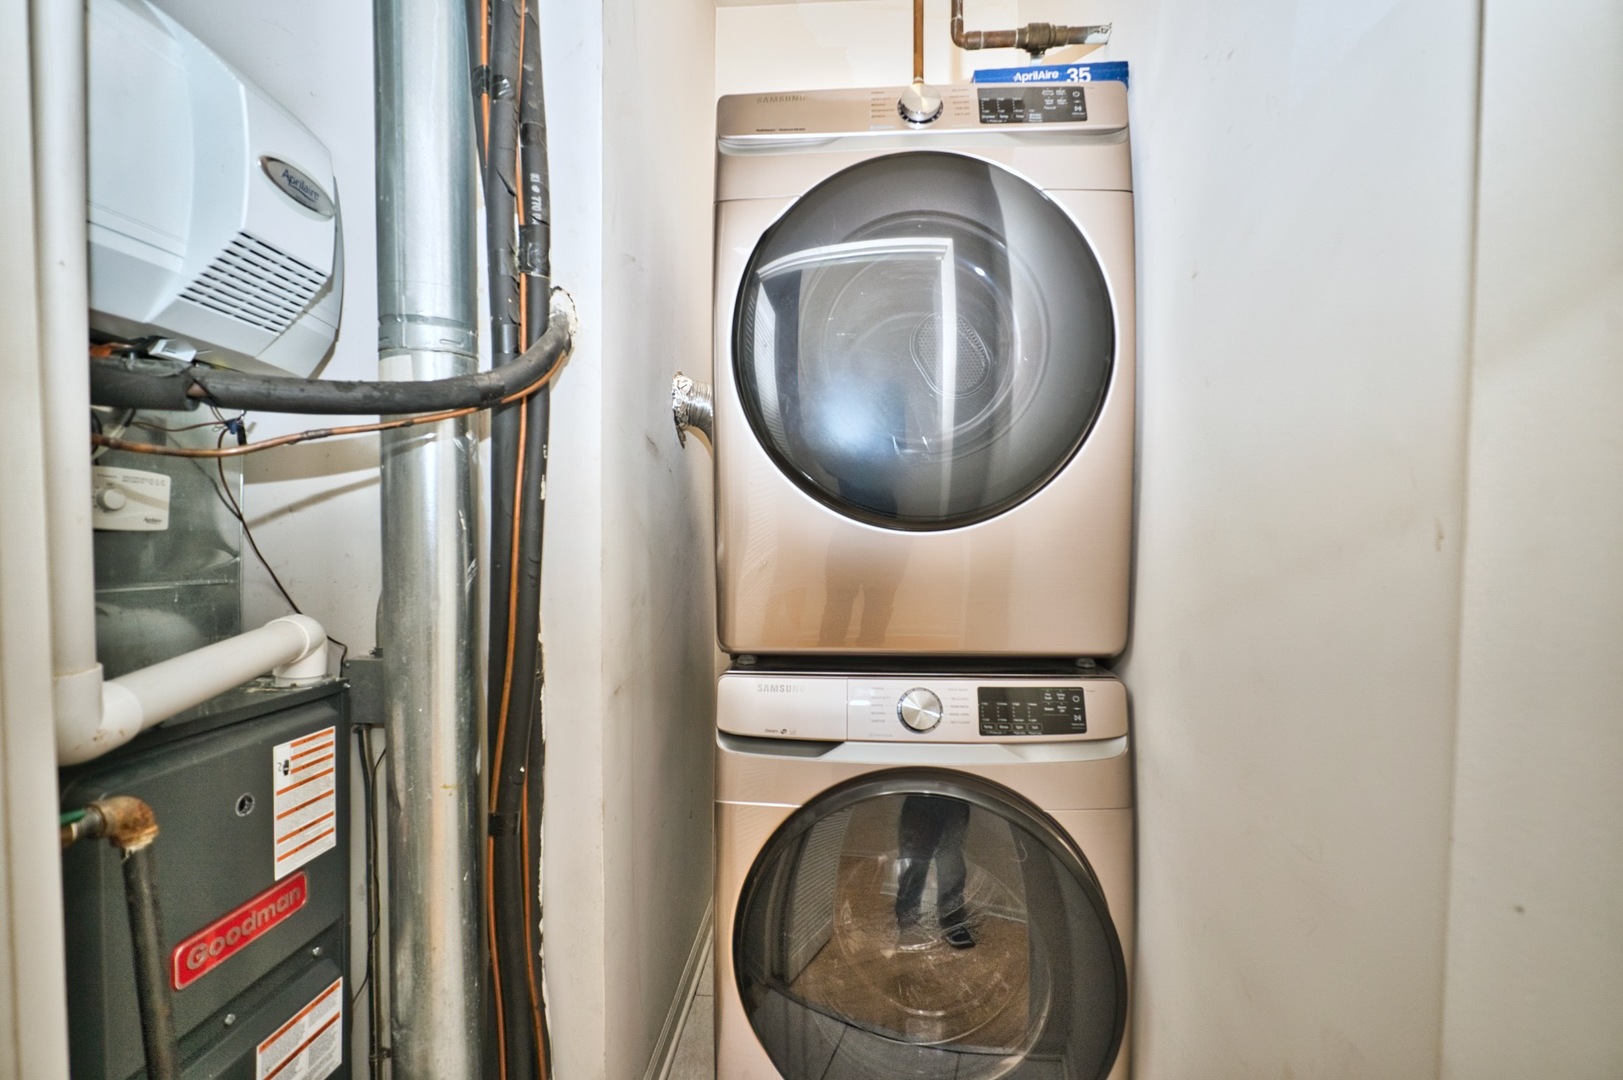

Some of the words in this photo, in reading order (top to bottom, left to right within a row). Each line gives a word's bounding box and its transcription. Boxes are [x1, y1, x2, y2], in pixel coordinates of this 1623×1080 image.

[1013, 70, 1059, 82] AprilAire
[1067, 67, 1091, 82] 35
[282, 169, 320, 200] Aprilaire
[186, 887, 301, 970] Goodman
